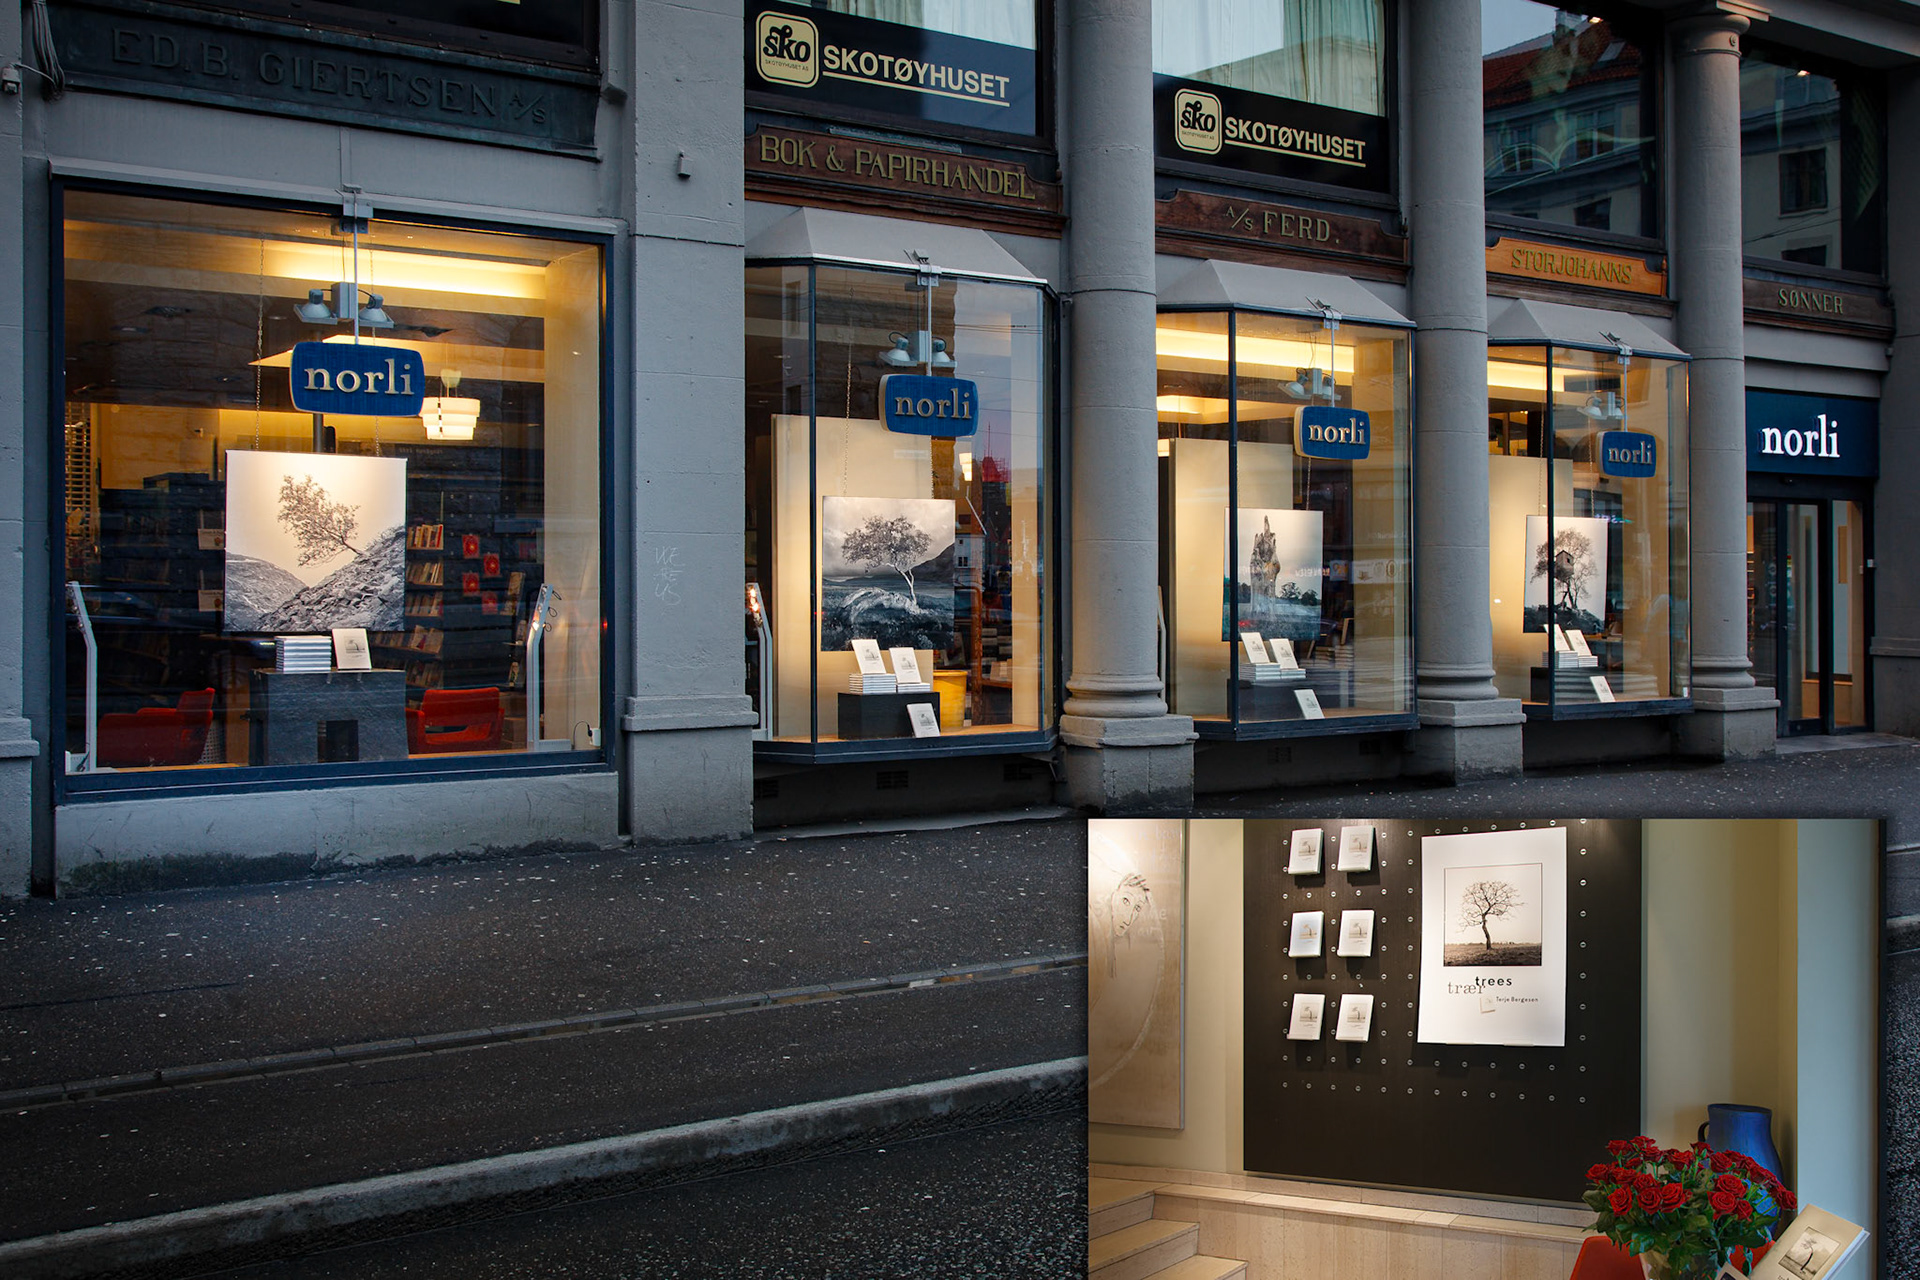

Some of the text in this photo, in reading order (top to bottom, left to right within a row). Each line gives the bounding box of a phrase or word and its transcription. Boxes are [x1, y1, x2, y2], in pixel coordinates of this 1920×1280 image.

[259, 52, 496, 117] GIERTSEN
[823, 45, 1010, 98] SKOTØYHUSET
[1225, 116, 1366, 160] SKOTØYHUSET
[760, 134, 1035, 199] BOK & PAPIRHANDEL
[1263, 210, 1340, 244] FERD.
[1511, 248, 1632, 284] STORJOHANNS
[1778, 288, 1843, 314] SØNNER
[304, 358, 415, 395] norli
[894, 387, 972, 419] norli
[1308, 417, 1366, 445] norli
[1761, 413, 1840, 458] norli
[1608, 441, 1652, 465] norli
[1447, 981, 1486, 994] trær
[1475, 976, 1512, 986] trees
